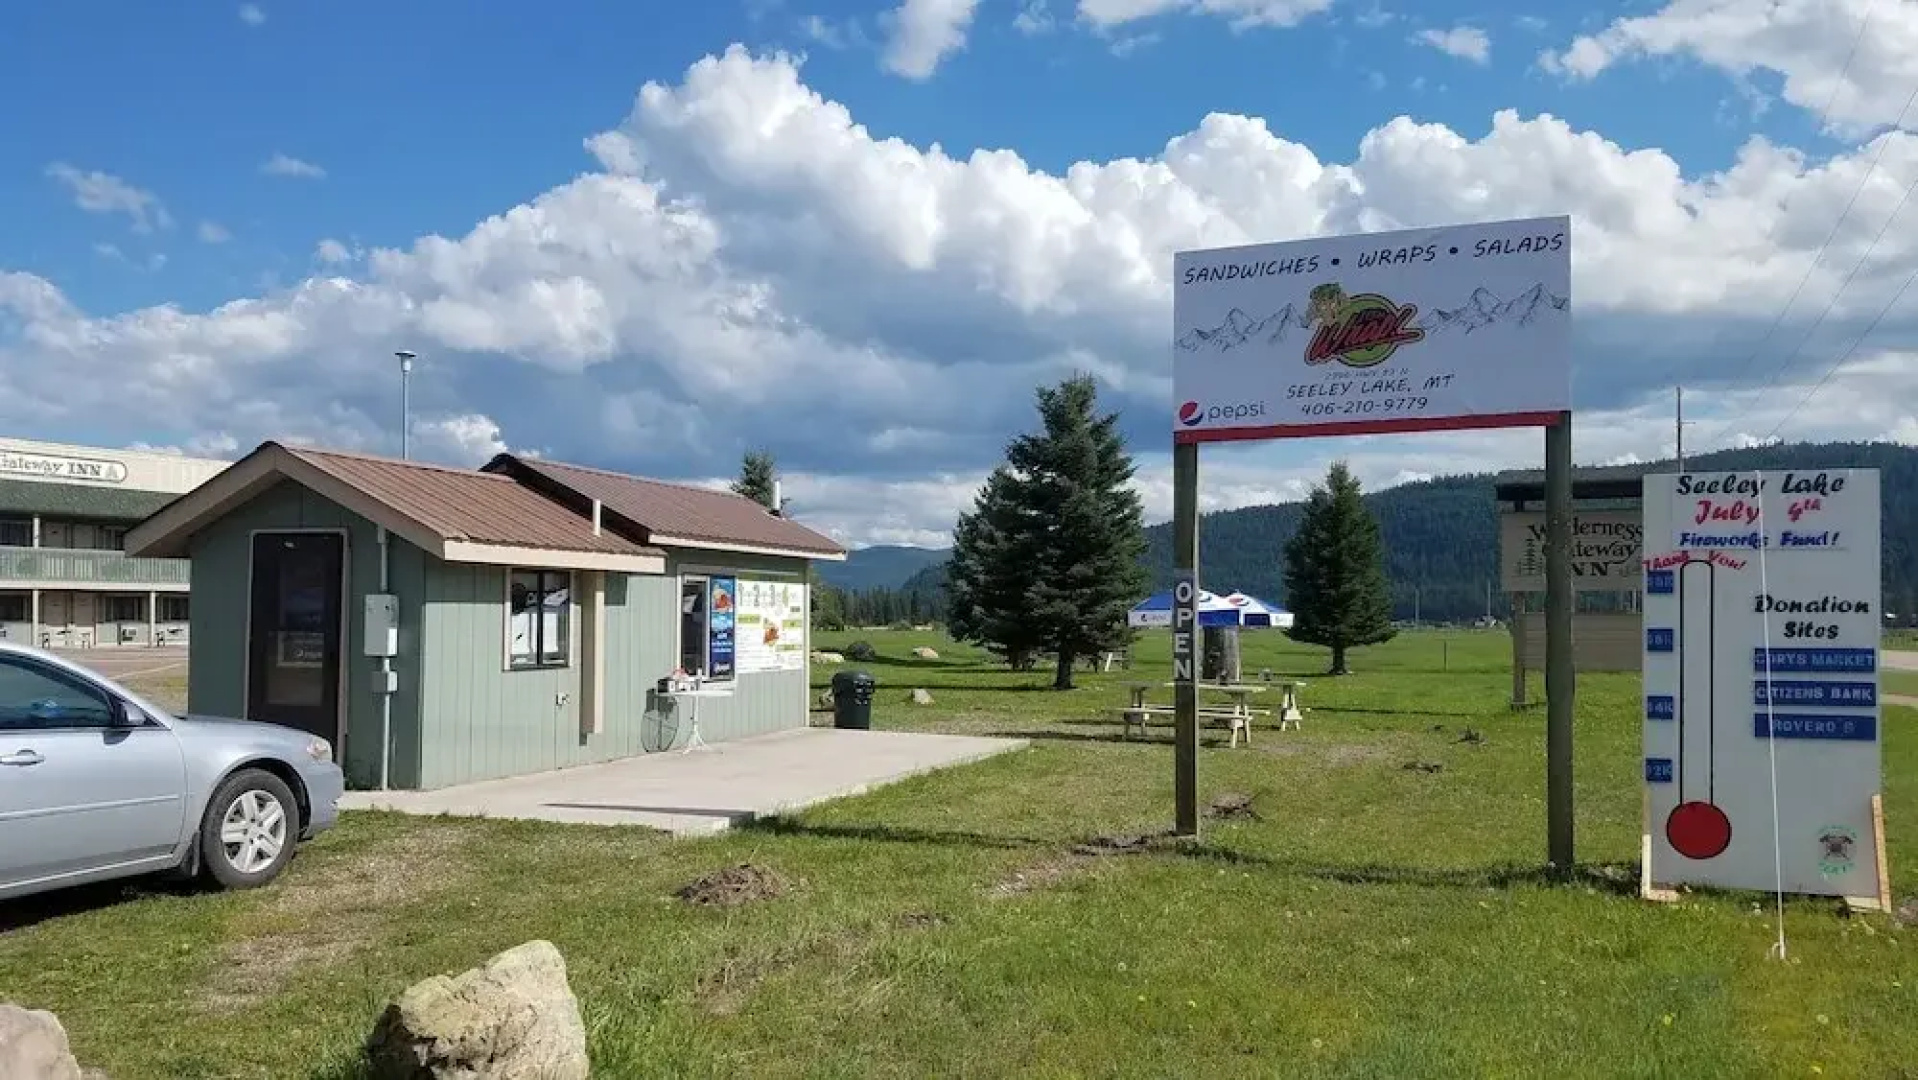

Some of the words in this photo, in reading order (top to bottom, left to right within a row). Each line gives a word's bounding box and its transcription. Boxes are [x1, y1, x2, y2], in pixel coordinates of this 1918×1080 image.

[1184, 255, 1320, 284] SANDWICHES
[1357, 245, 1437, 268] WRAPS
[1473, 233, 1564, 258] SALADS
[1287, 381, 1352, 399] SEELEY
[1423, 373, 1455, 390] MT
[1208, 401, 1266, 422] pepsi
[1302, 397, 1428, 415] 406-210-9779
[67, 461, 102, 476] INN
[1676, 473, 1767, 498] Seeley
[1781, 473, 1844, 497] Lake
[1694, 500, 1760, 525] July
[1754, 594, 1869, 613] Donation
[1175, 582, 1193, 680] OPEN
[1784, 621, 1839, 639] Sites
[1812, 653, 1873, 666] MARKET
[1756, 687, 1823, 699] CTIZENS
[1831, 688, 1872, 701] BANK
